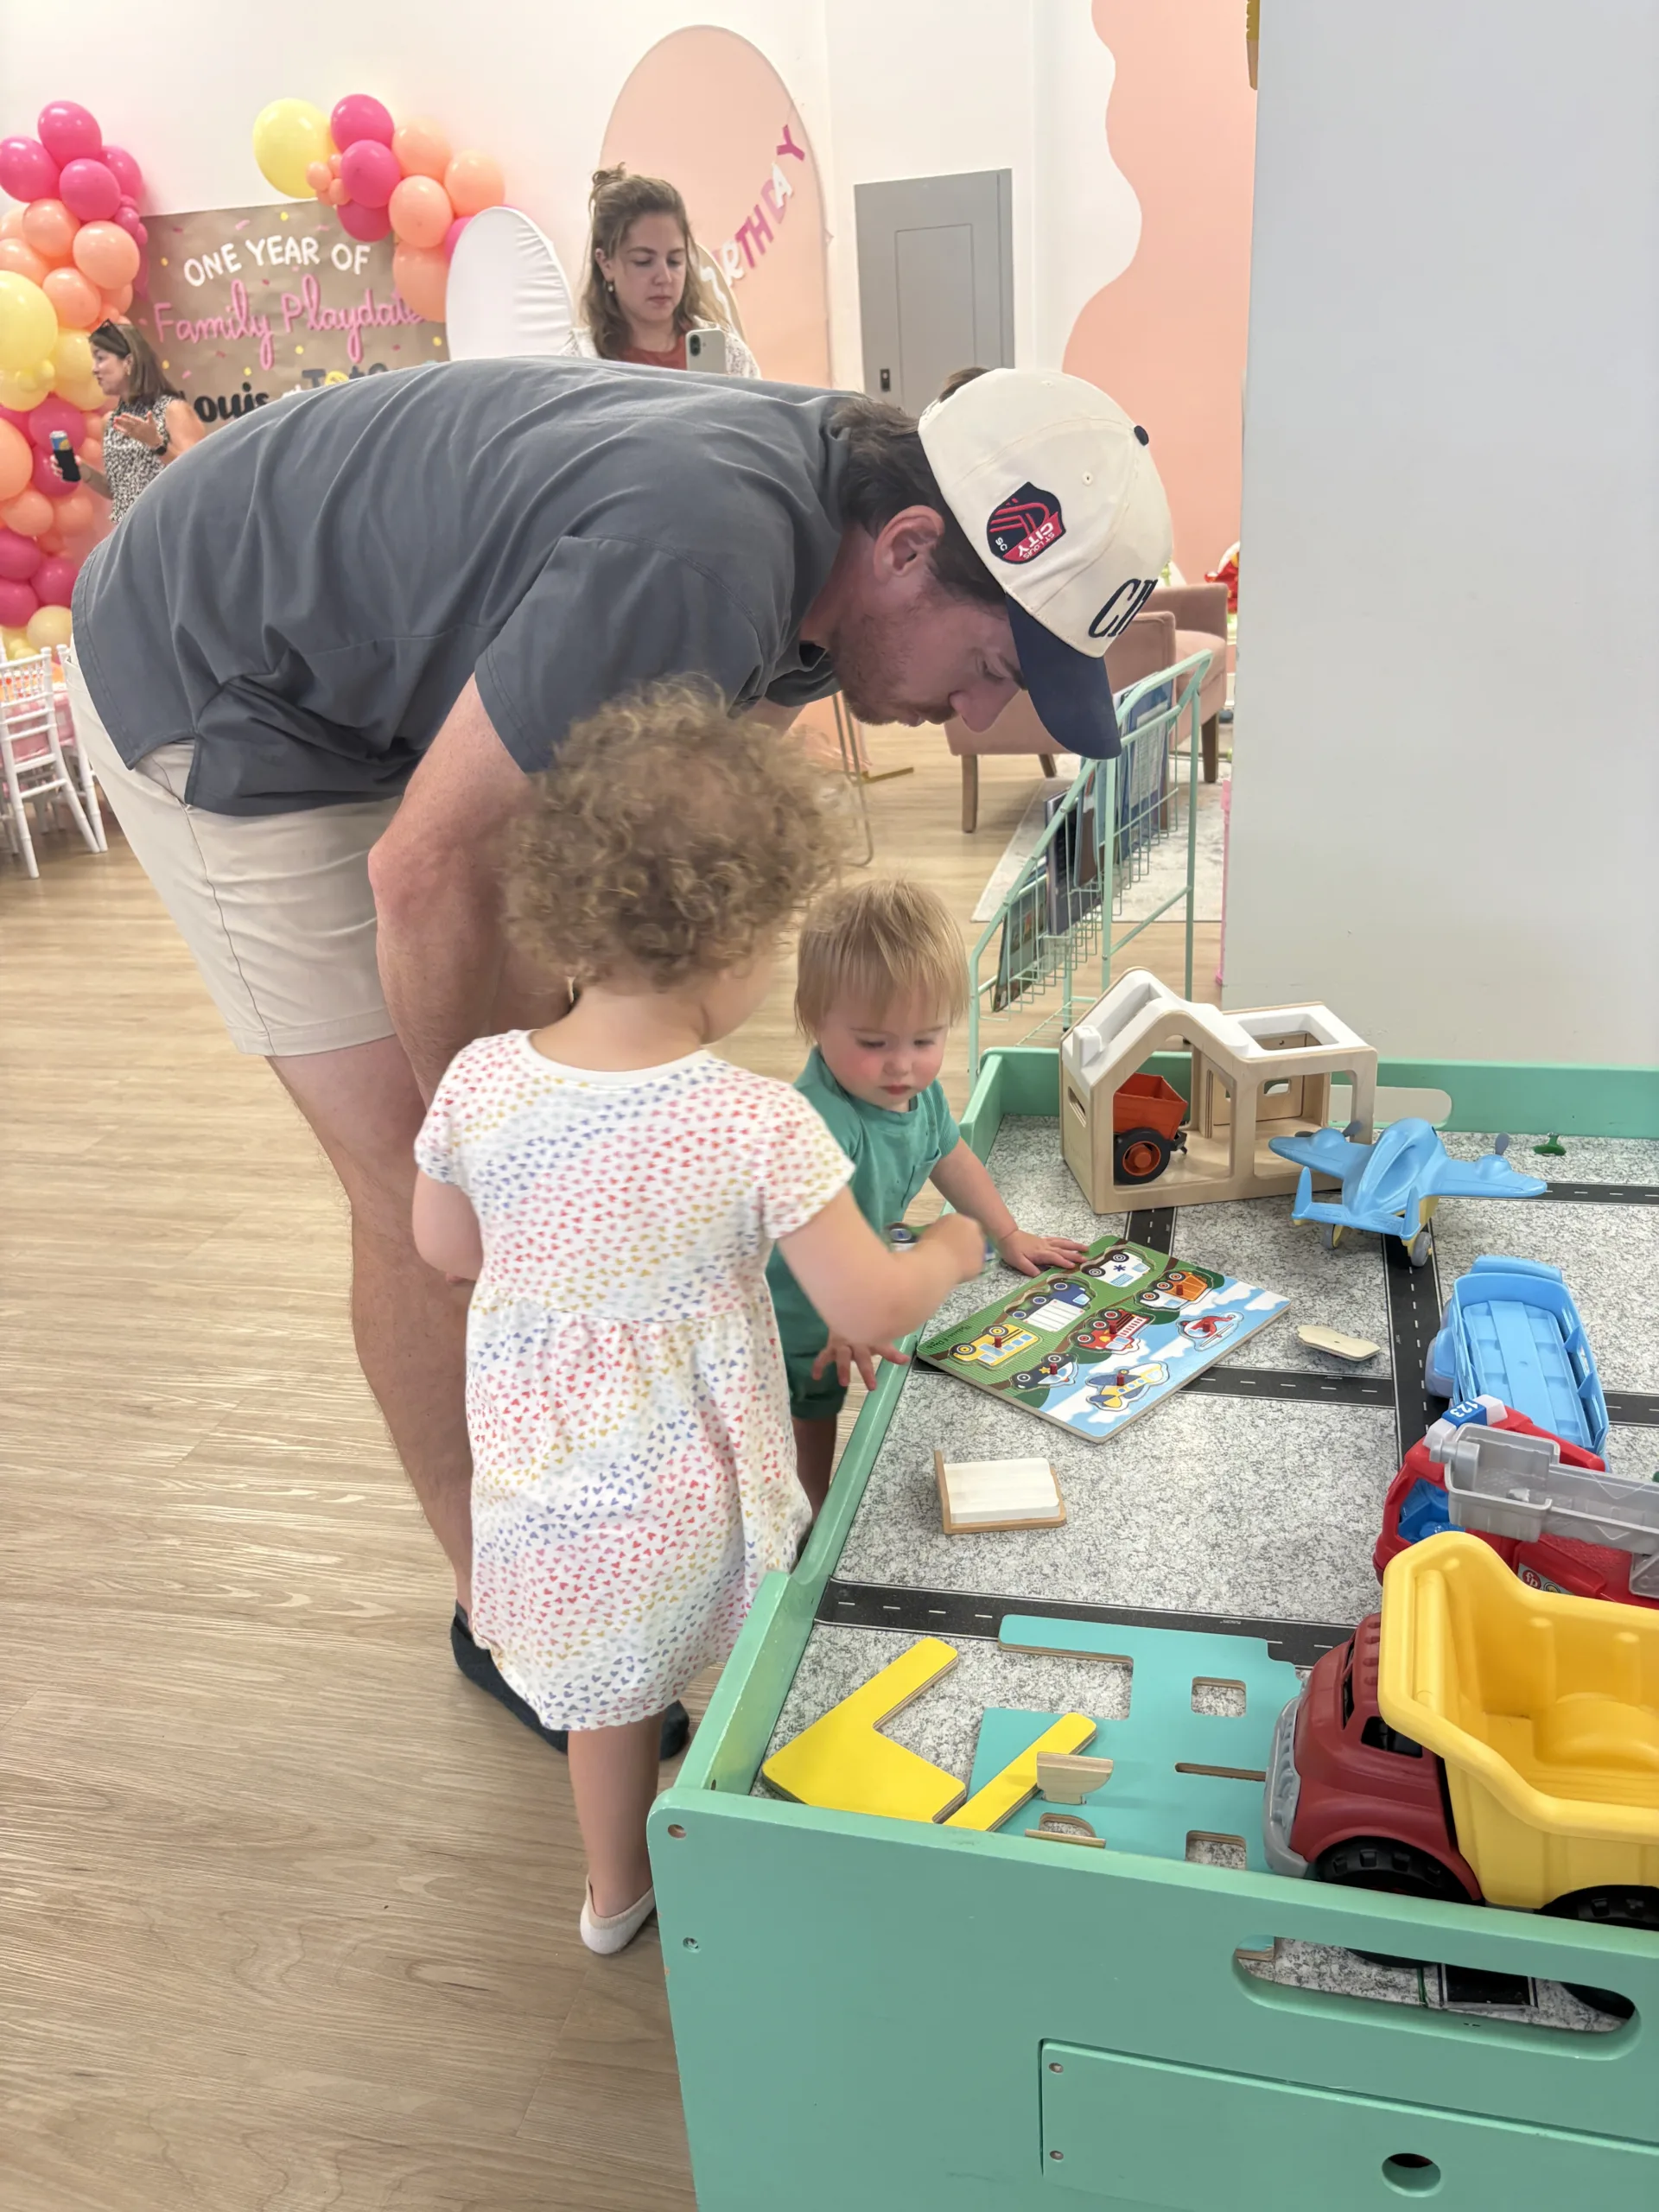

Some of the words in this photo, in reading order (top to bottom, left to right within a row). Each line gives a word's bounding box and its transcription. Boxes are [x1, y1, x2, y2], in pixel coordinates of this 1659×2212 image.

[711, 124, 804, 288] RTHDAY
[183, 243, 242, 287] ONE
[245, 235, 320, 266] YEAR
[331, 244, 371, 275] OF
[154, 278, 274, 370] Family
[995, 537, 1008, 552] SC
[1018, 522, 1054, 558] CITY
[1044, 531, 1055, 543] ST
[1022, 541, 1045, 560] LOUIS
[1449, 1401, 1478, 1418] 123
[1525, 1572, 1539, 1588] fp
